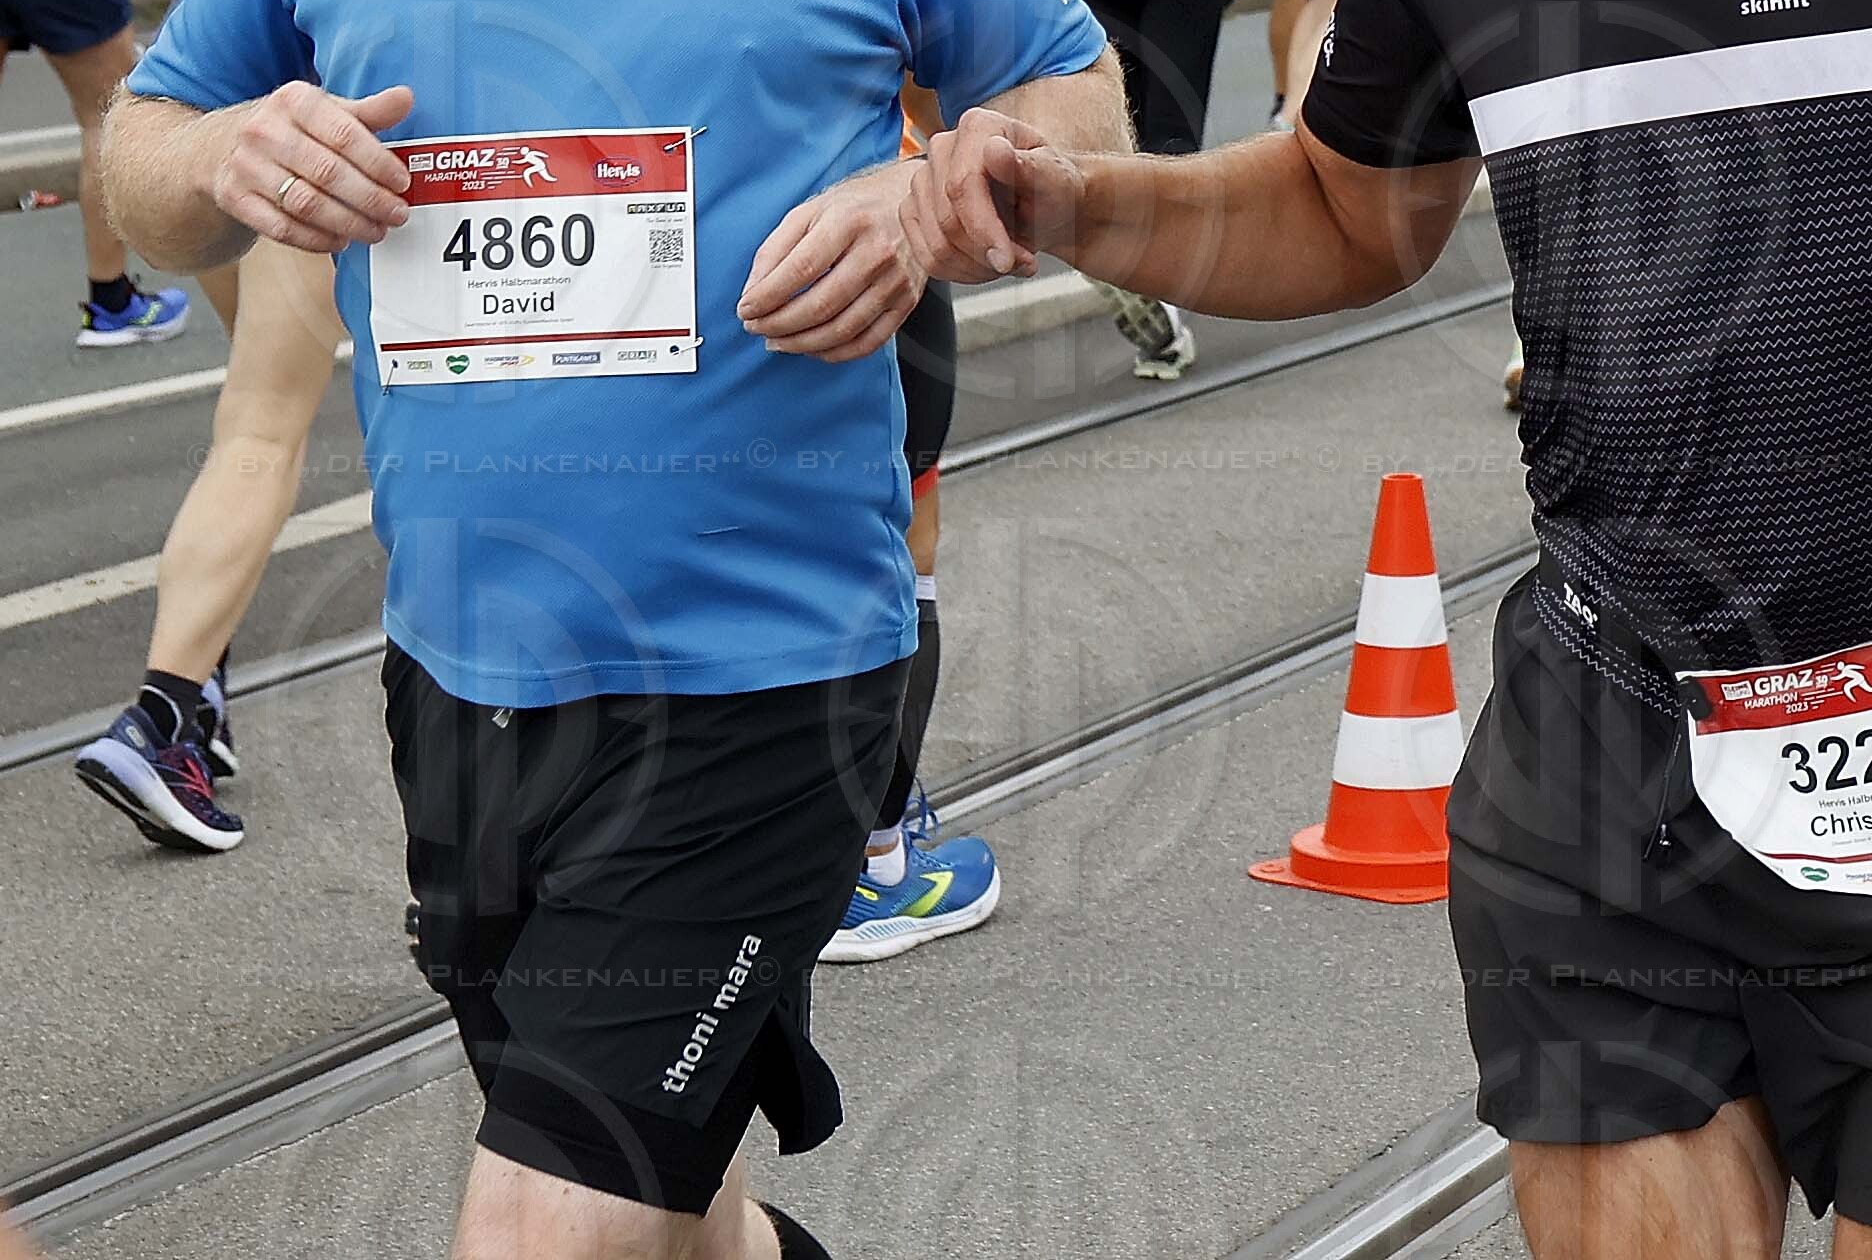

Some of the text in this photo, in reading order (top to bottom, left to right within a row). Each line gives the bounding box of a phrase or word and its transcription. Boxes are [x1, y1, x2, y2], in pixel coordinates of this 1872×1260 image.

[435, 148, 496, 170] GRAZ
[424, 169, 478, 184] MARATHON
[597, 162, 641, 180] Hervis
[462, 179, 486, 191] 2023
[442, 213, 596, 272] 4860
[467, 275, 572, 289] Hervis Halbmarathon
[482, 290, 555, 315] David
[1753, 668, 1814, 696] GRAZ
[1743, 691, 1798, 710] MARATHON
[1785, 702, 1809, 714] 2023
[1818, 798, 1847, 809] Hervis
[661, 934, 763, 1095] thoni mara
